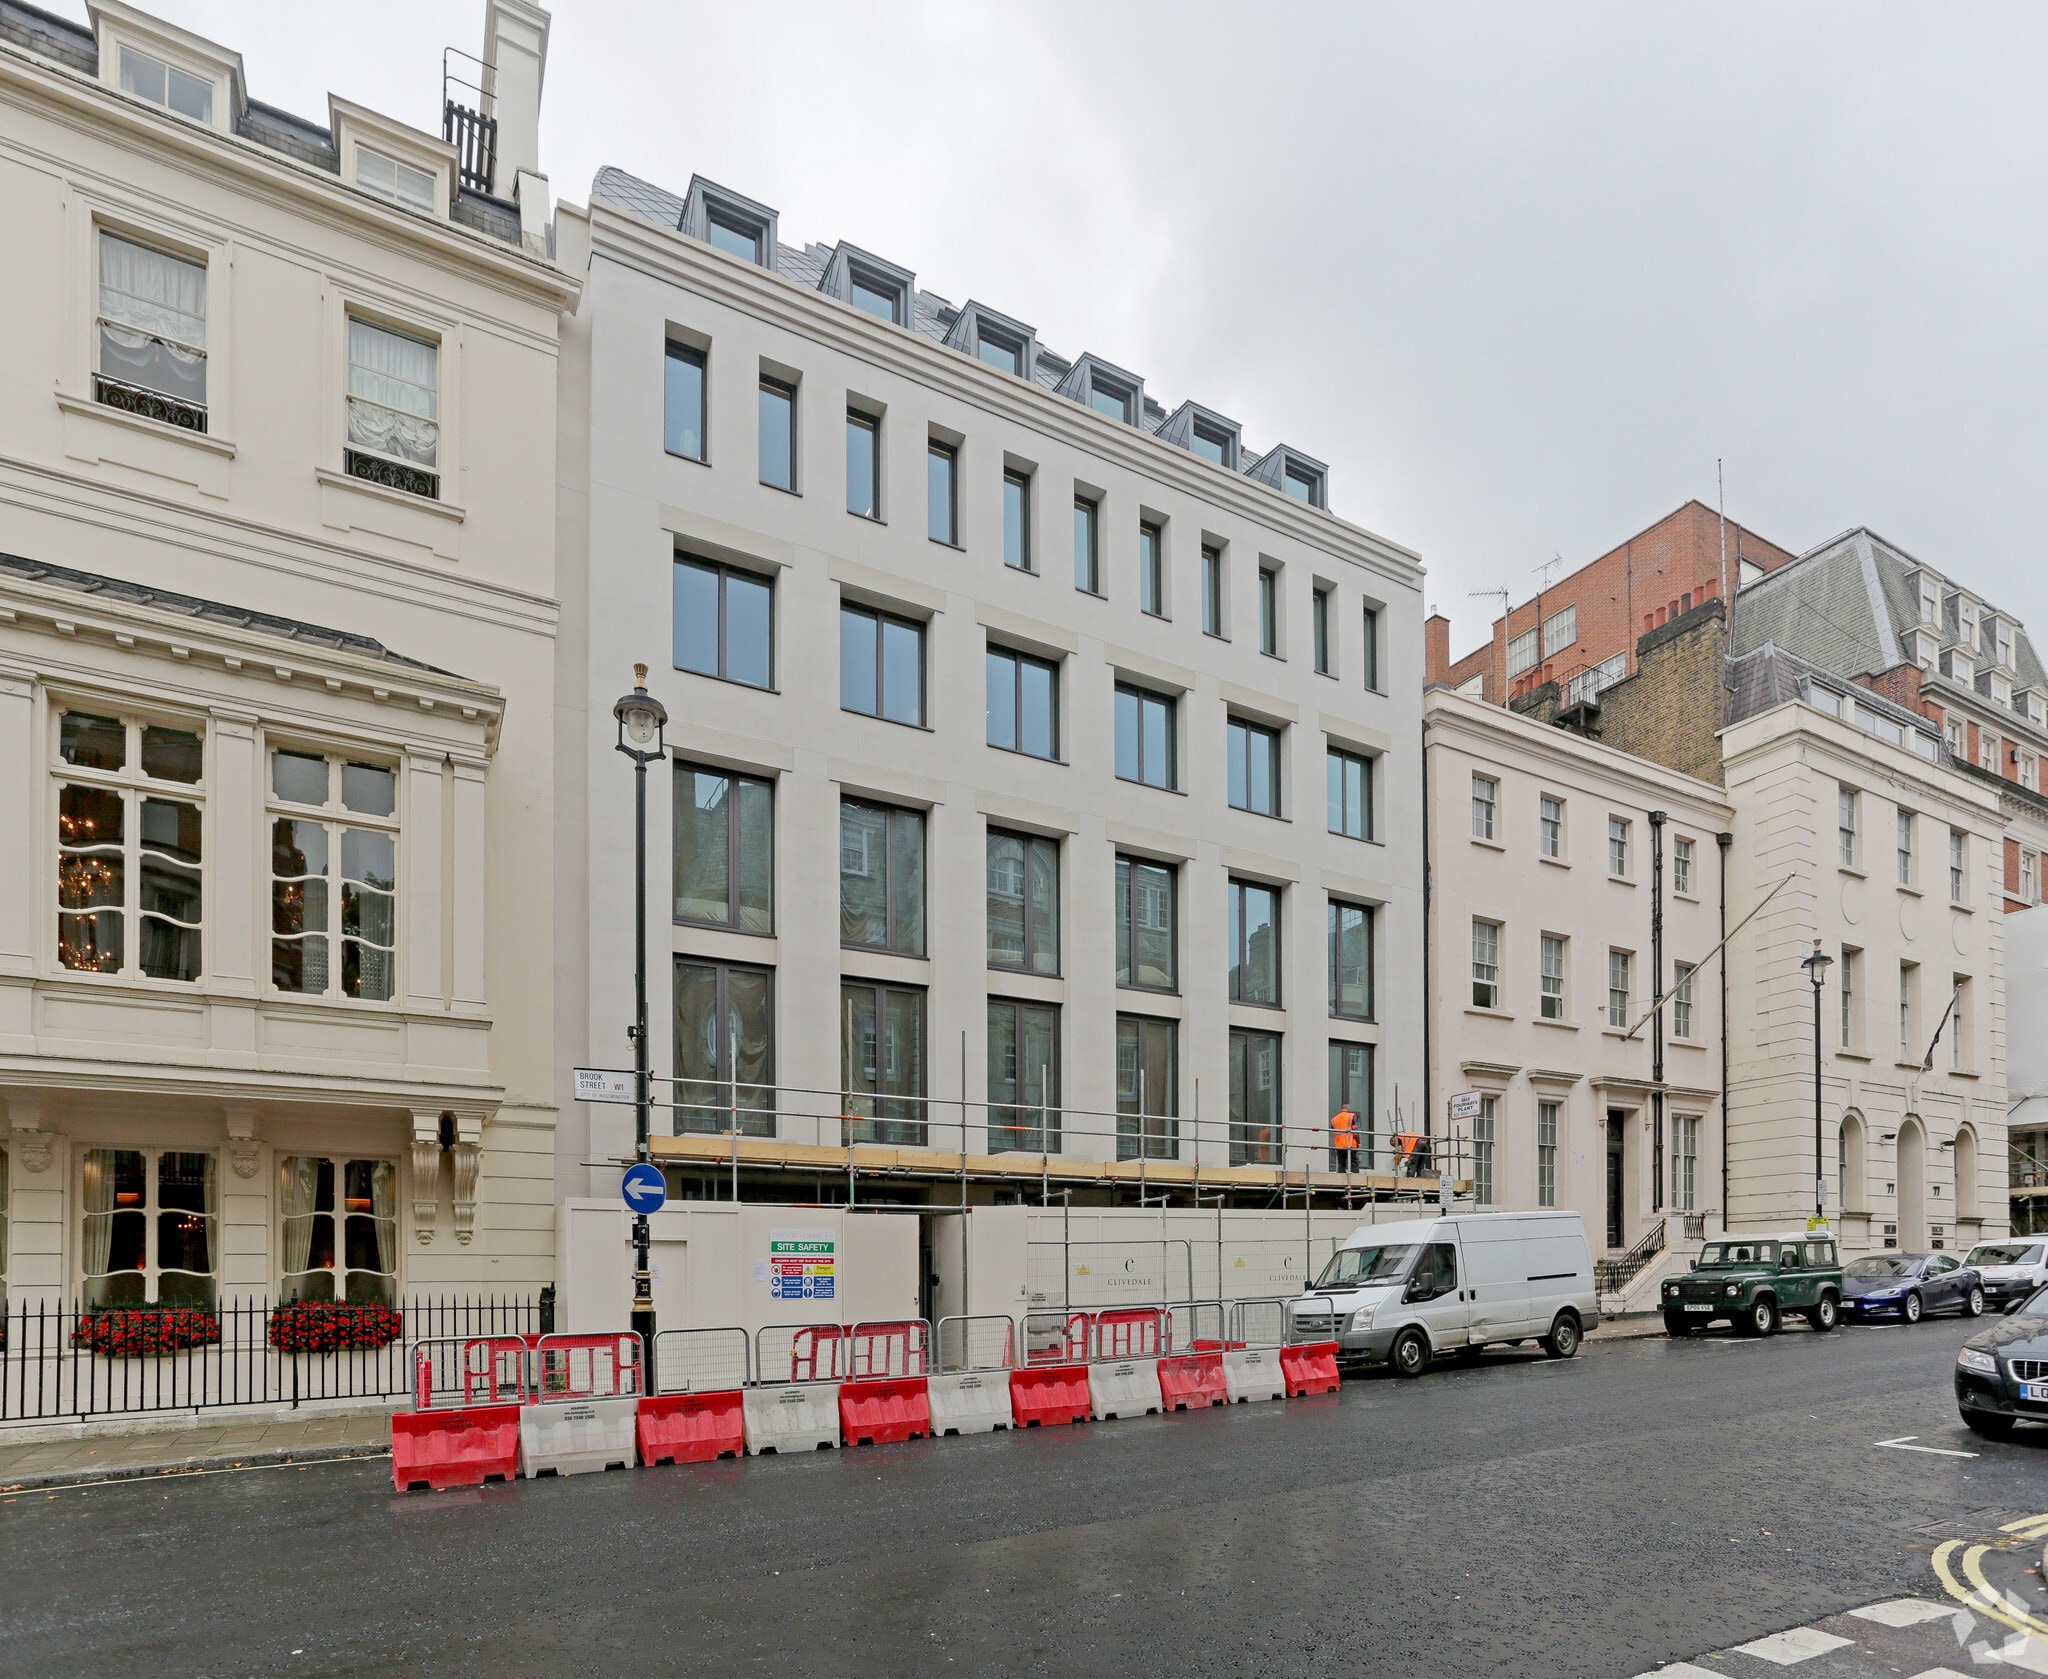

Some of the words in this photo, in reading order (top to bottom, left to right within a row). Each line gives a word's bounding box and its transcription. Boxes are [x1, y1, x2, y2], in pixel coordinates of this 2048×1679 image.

[580, 1072, 603, 1081] BROOK
[580, 1080, 606, 1089] STREET
[614, 1083, 624, 1091] W1
[1887, 1183, 1895, 1194] 77
[1932, 1186, 1940, 1196] 77
[777, 1243, 795, 1251] SITE
[798, 1243, 829, 1251] SAFETY
[1125, 1258, 1134, 1273] C
[1284, 1255, 1292, 1269] C
[1107, 1278, 1152, 1286] CLIVEDALE
